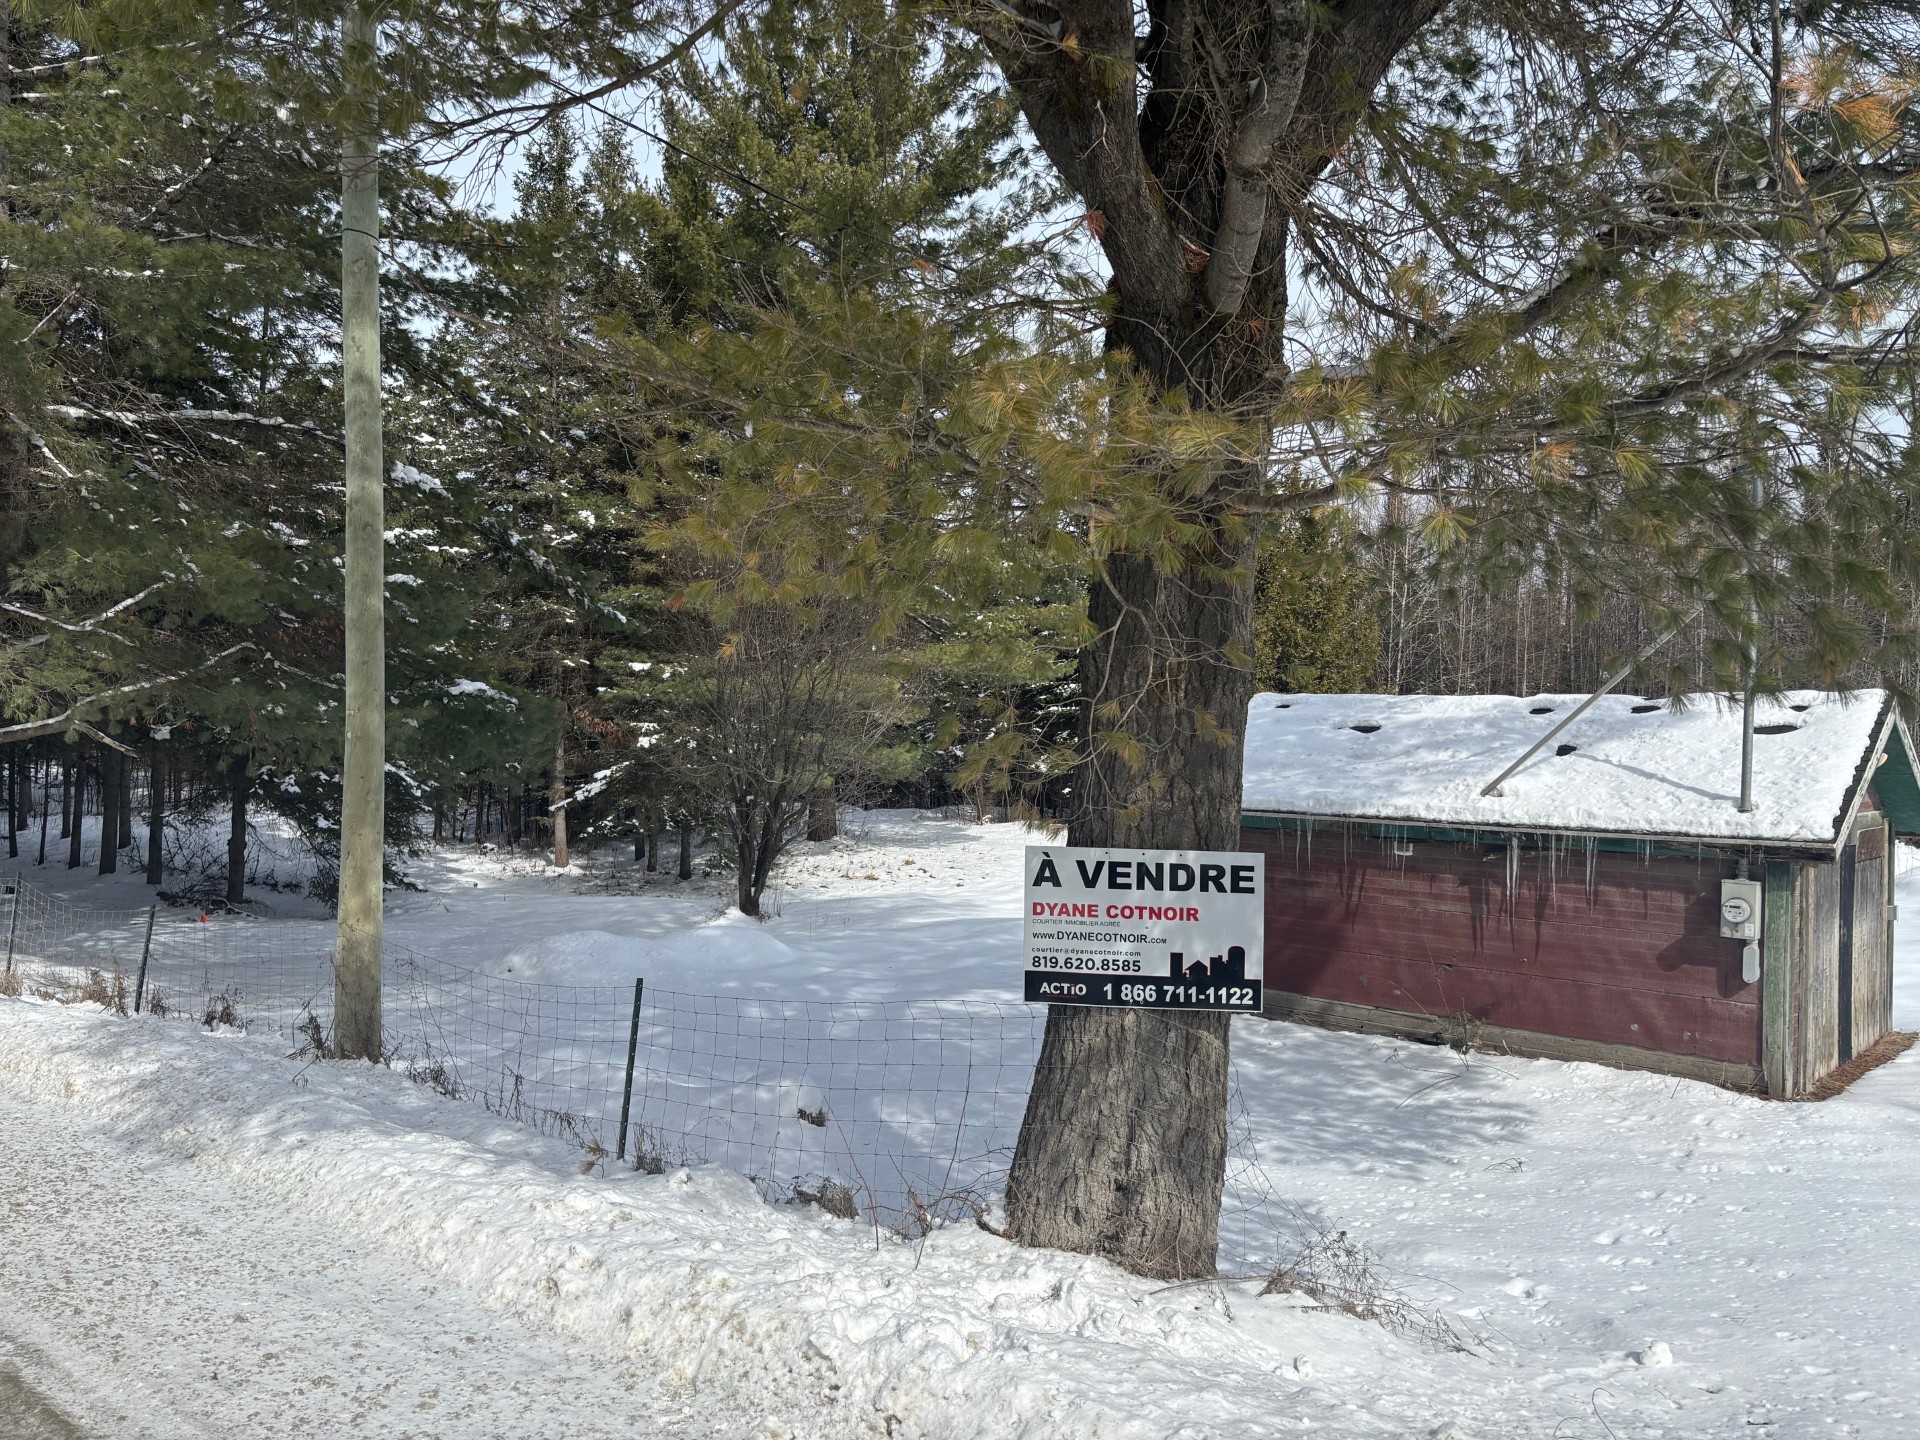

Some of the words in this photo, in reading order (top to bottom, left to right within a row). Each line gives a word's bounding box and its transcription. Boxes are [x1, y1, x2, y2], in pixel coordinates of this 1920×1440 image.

[1032, 852, 1062, 887] À
[1076, 860, 1255, 894] VENDRE
[1032, 902, 1098, 918] DYANE
[1106, 905, 1199, 922] COTNOIR
[1032, 947, 1141, 957] courtier@dyanecotnoir.com
[1032, 956, 1141, 972] 819.620.8585
[1104, 983, 1112, 999] 1
[1121, 984, 1156, 1002] 866
[1163, 986, 1253, 1004] 711-1122
